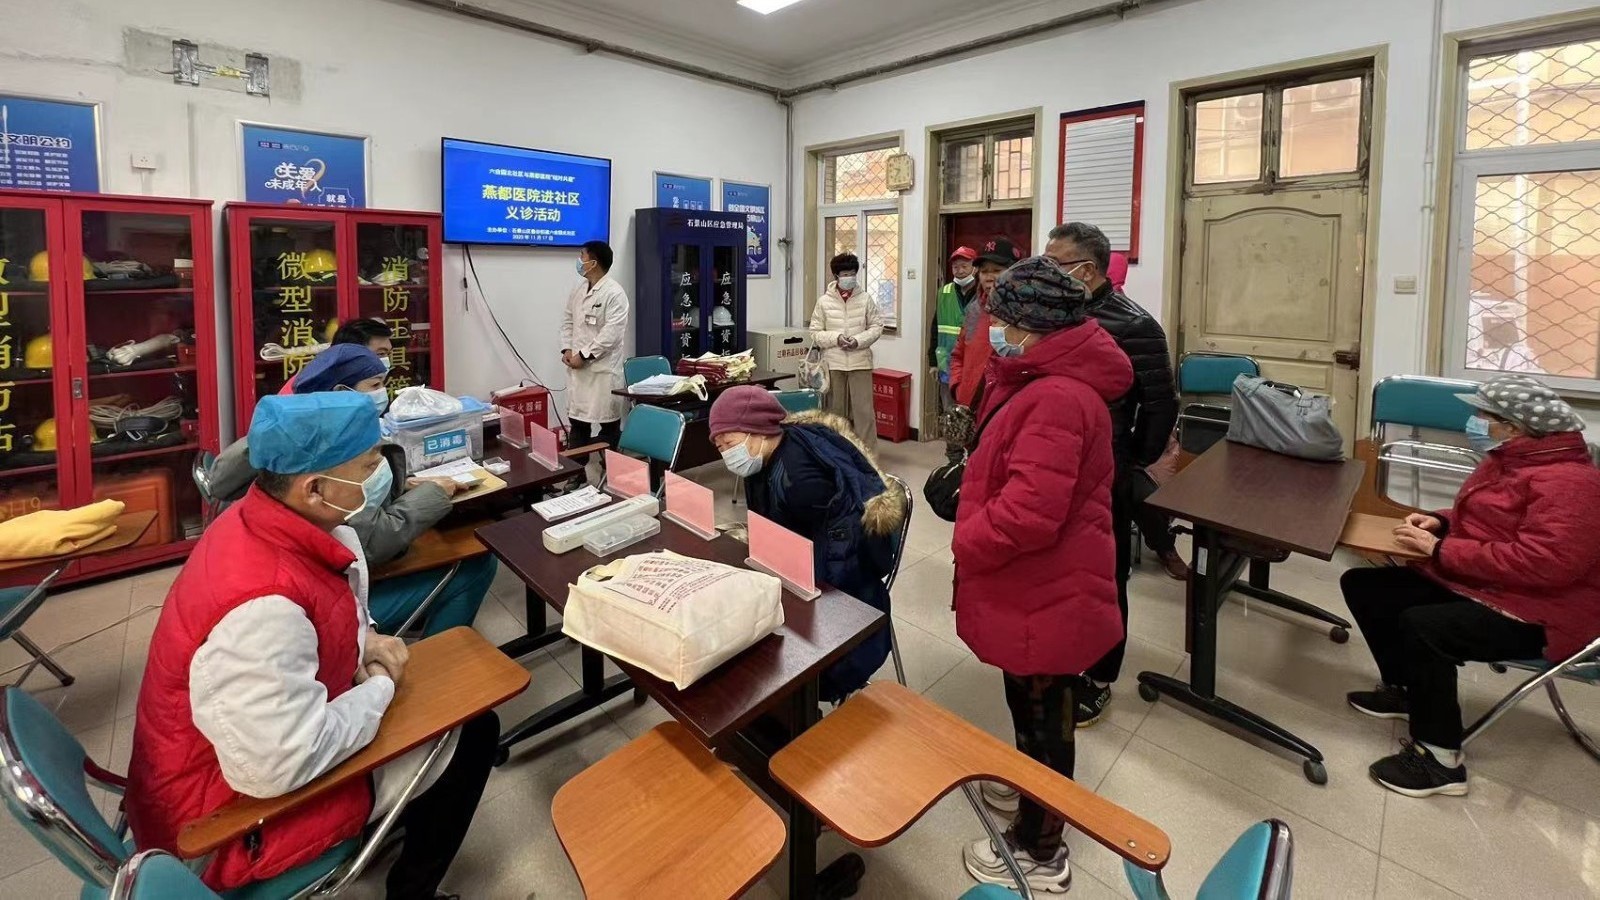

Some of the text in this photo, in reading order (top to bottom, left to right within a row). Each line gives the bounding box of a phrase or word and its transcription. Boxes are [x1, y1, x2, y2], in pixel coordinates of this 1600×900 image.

[326, 194, 347, 203] 就是
[482, 184, 580, 206] 燕都医院进社区
[505, 206, 561, 222] 义诊活动
[687, 218, 745, 230] 石景山区应急管理局
[427, 434, 463, 450] 已消毒
